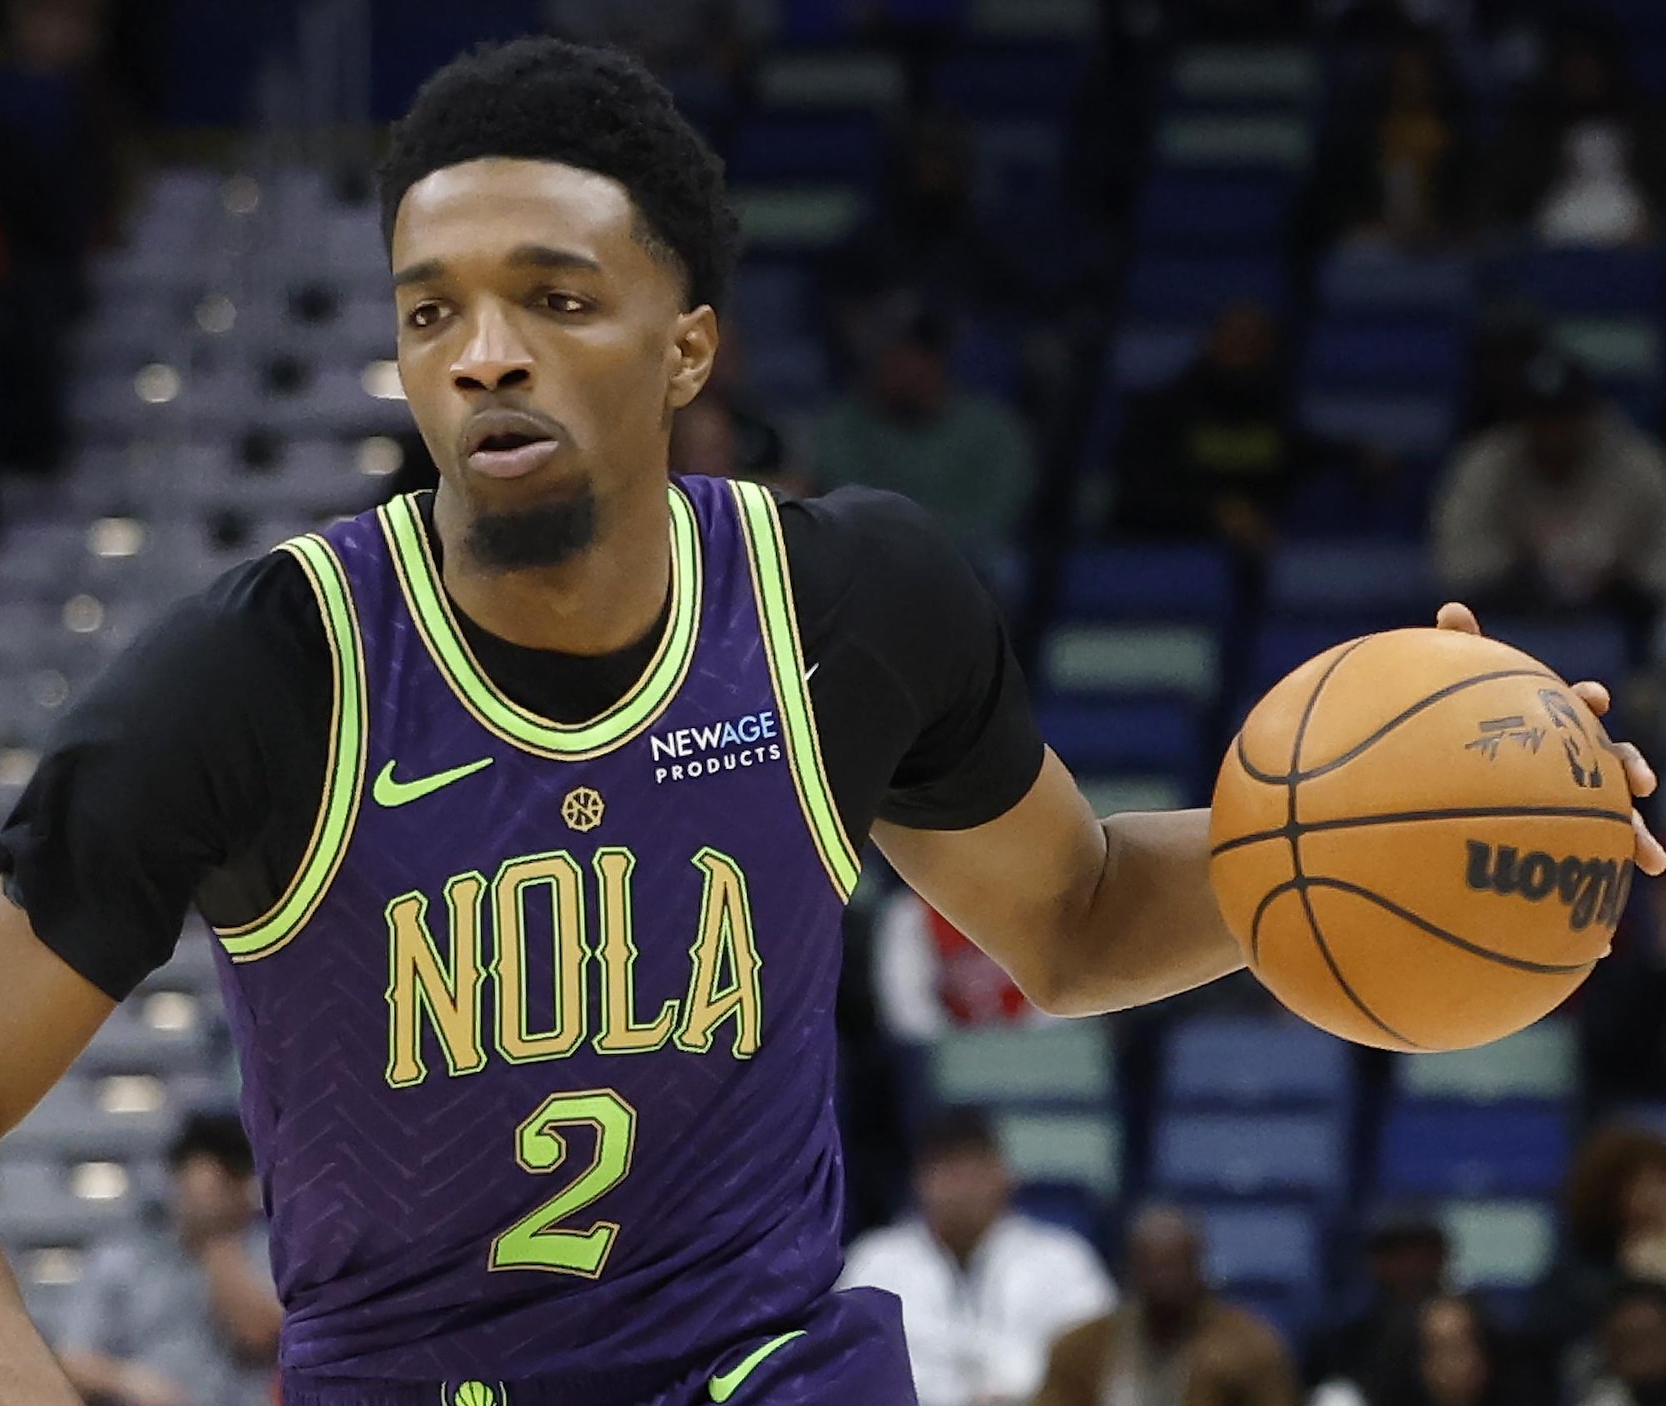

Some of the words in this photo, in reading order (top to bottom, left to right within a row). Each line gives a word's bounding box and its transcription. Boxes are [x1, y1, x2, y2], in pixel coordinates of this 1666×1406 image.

[650, 711, 777, 761] NEWAGE
[655, 744, 781, 784] PRODUCTS
[384, 846, 763, 1088] NOLA
[488, 1087, 638, 1279] 2
